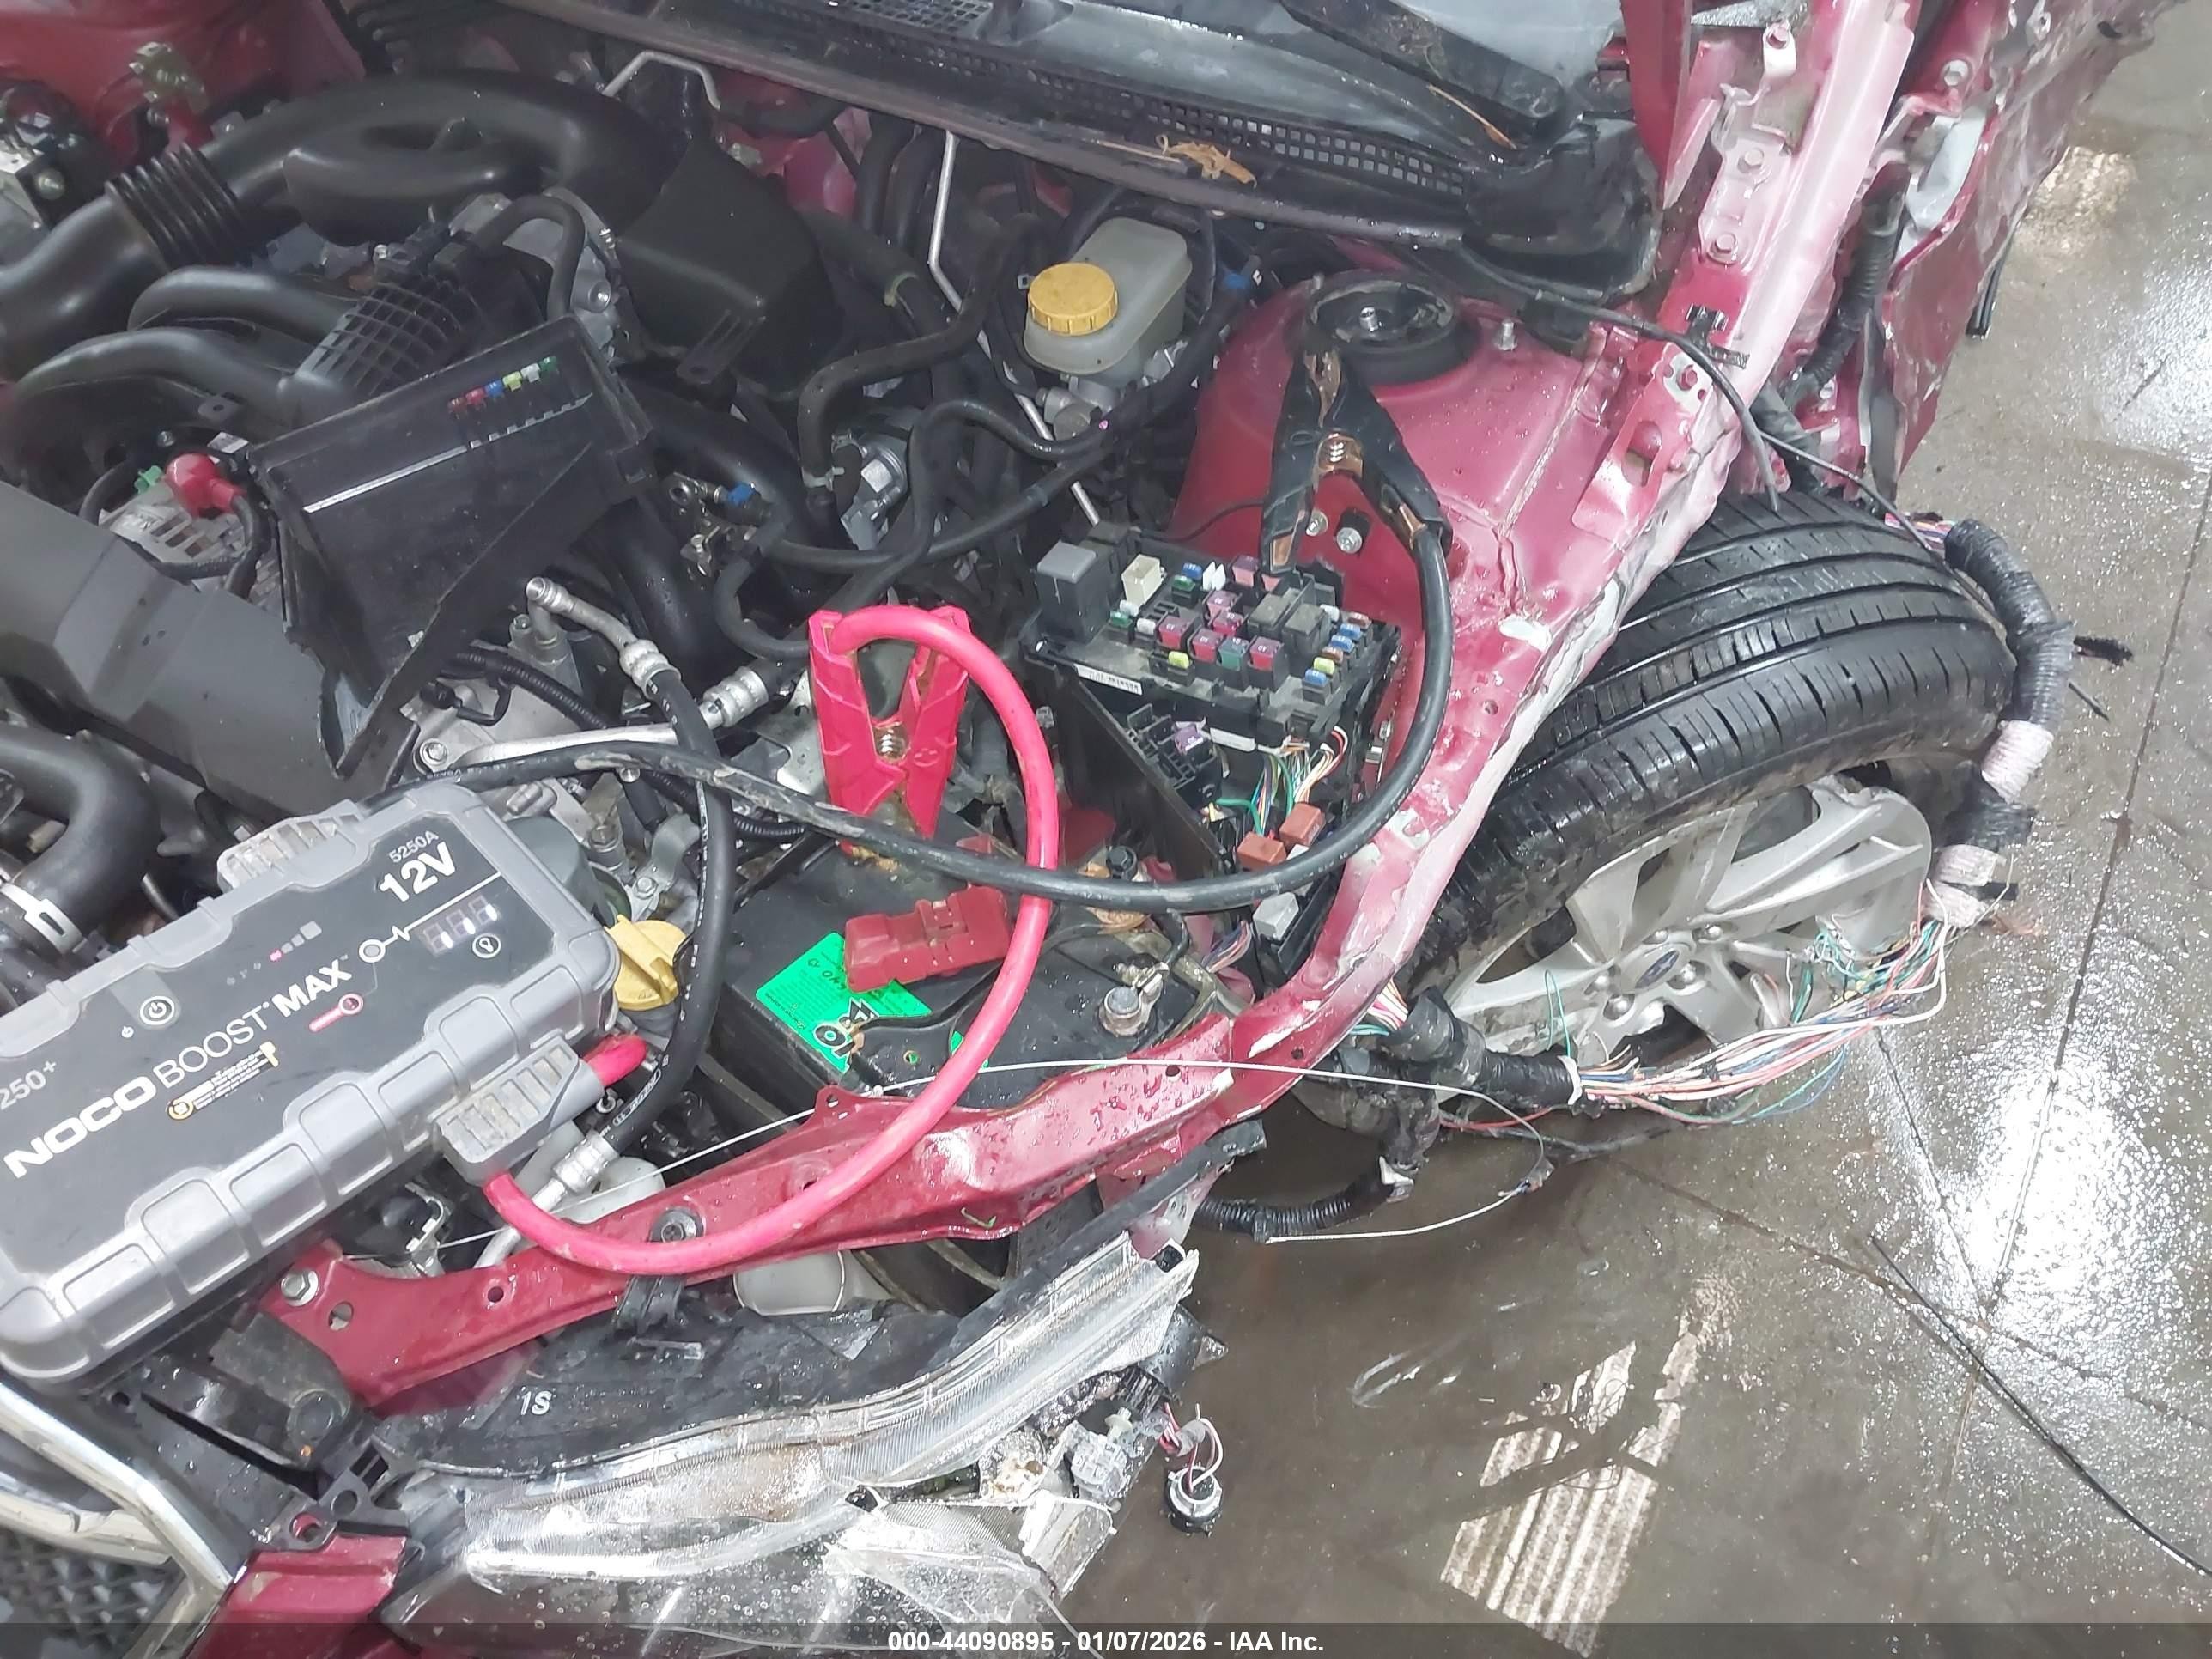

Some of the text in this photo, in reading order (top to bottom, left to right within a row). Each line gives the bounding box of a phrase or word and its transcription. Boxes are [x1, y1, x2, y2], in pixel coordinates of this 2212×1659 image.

[380, 842, 455, 902] 12V
[389, 830, 439, 863] 5250A
[3, 1076, 156, 1178] NOCO
[153, 1005, 268, 1089] BOOST
[272, 959, 352, 1018] MAX
